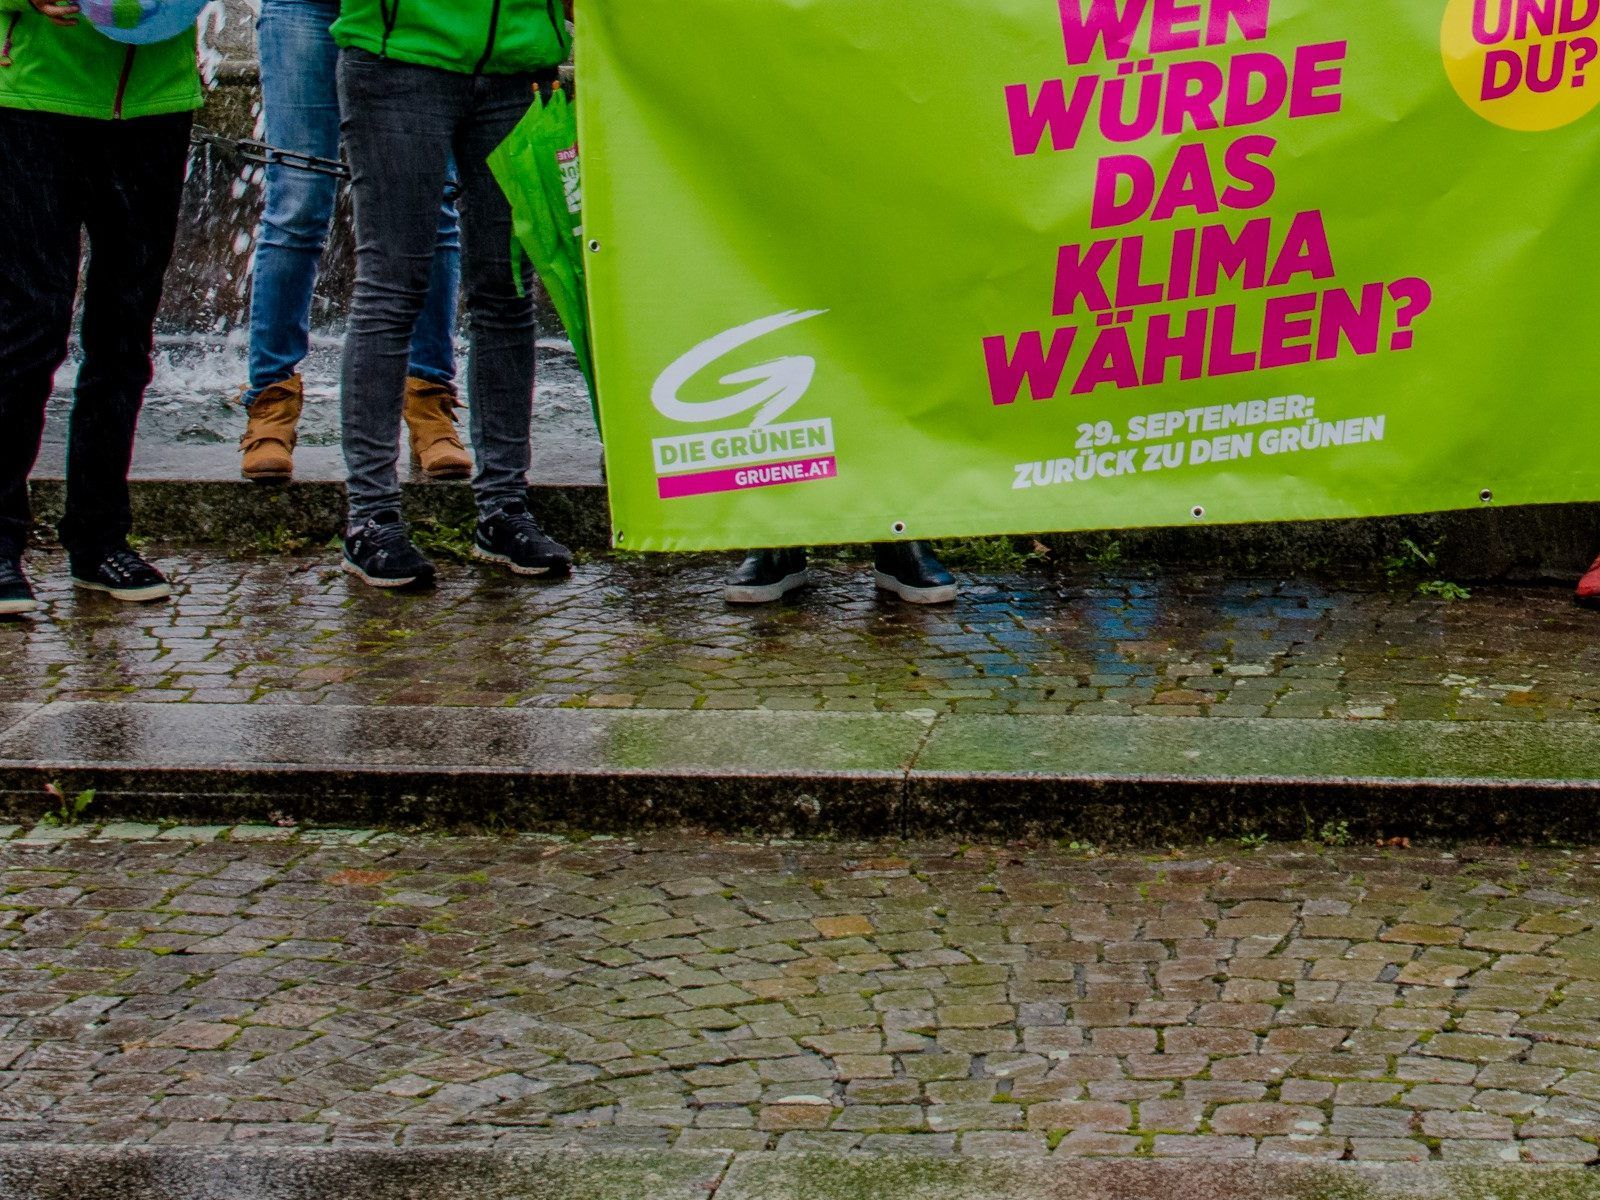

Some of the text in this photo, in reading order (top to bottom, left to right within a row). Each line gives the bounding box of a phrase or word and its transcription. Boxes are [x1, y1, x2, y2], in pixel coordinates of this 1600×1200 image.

[1004, 40, 1348, 156] WÜRDE
[1480, 36, 1598, 101] DU?
[1091, 134, 1277, 229] DAS
[1052, 210, 1335, 316] KLIMA
[982, 277, 1432, 406] WÄHLEN?
[659, 425, 827, 466] DIE GRÜNEN
[1011, 415, 1385, 490] ZURÜCK ZU DEN GRÜNEN
[1075, 394, 1315, 449] 29. SEPTEMBER:
[734, 460, 830, 486] GRUENE.AT
